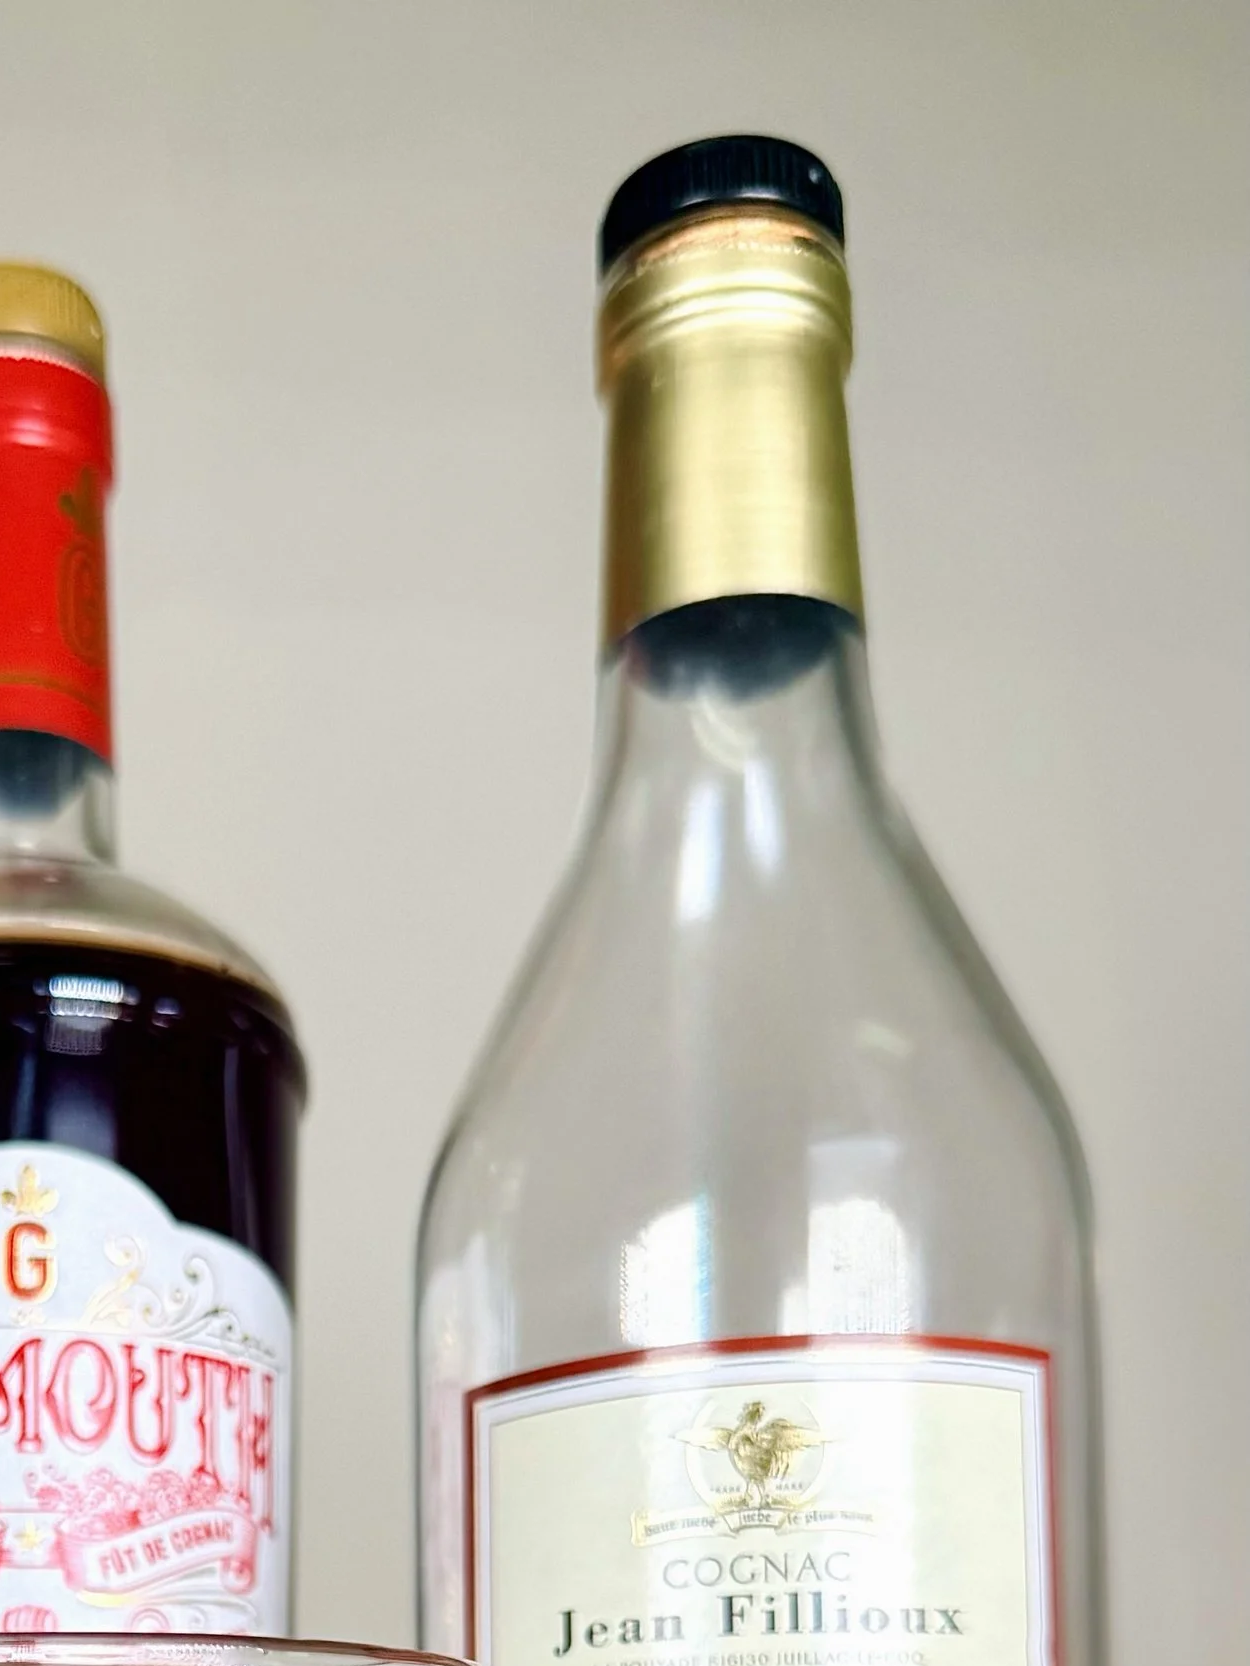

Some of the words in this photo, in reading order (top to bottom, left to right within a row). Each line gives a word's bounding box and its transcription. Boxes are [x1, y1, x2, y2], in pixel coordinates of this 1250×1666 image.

[3, 1221, 51, 1301] G
[663, 1550, 852, 1590] COGNAC
[553, 1608, 686, 1658] Jean
[716, 1589, 970, 1638] Fillioux
